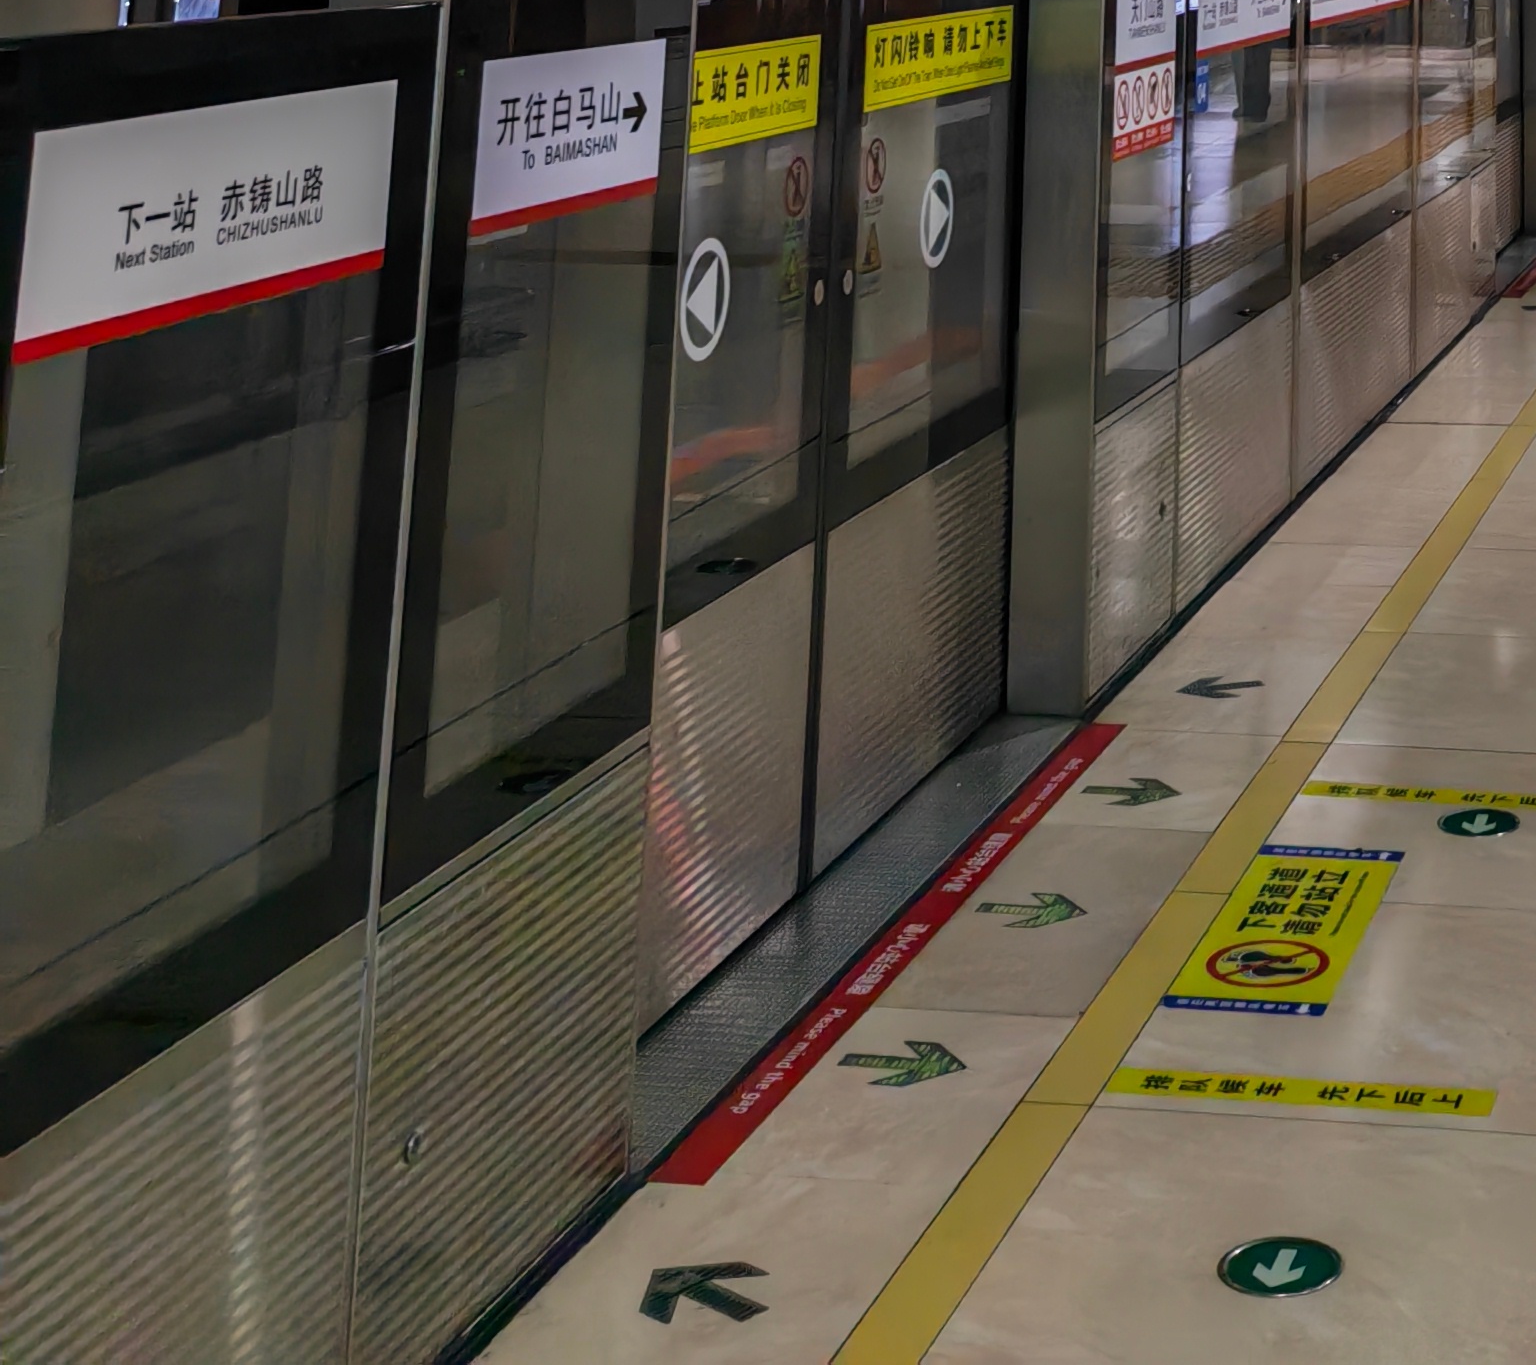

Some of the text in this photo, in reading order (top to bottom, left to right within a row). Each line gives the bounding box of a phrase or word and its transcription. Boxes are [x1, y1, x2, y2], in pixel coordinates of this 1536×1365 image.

[496, 81, 621, 146] 开往白马山
[522, 132, 618, 170] To BAIMASHAN
[118, 164, 324, 245] 下一站 赤铸山路
[216, 205, 324, 246] CHIZHUSHANLU
[114, 239, 195, 272] Next Station
[1236, 866, 1309, 934] 下客通道
[1280, 869, 1351, 936] 请勿站立
[730, 1007, 848, 1115] Please mind the gap
[1139, 1074, 1465, 1111] 排队候车 先下后上
